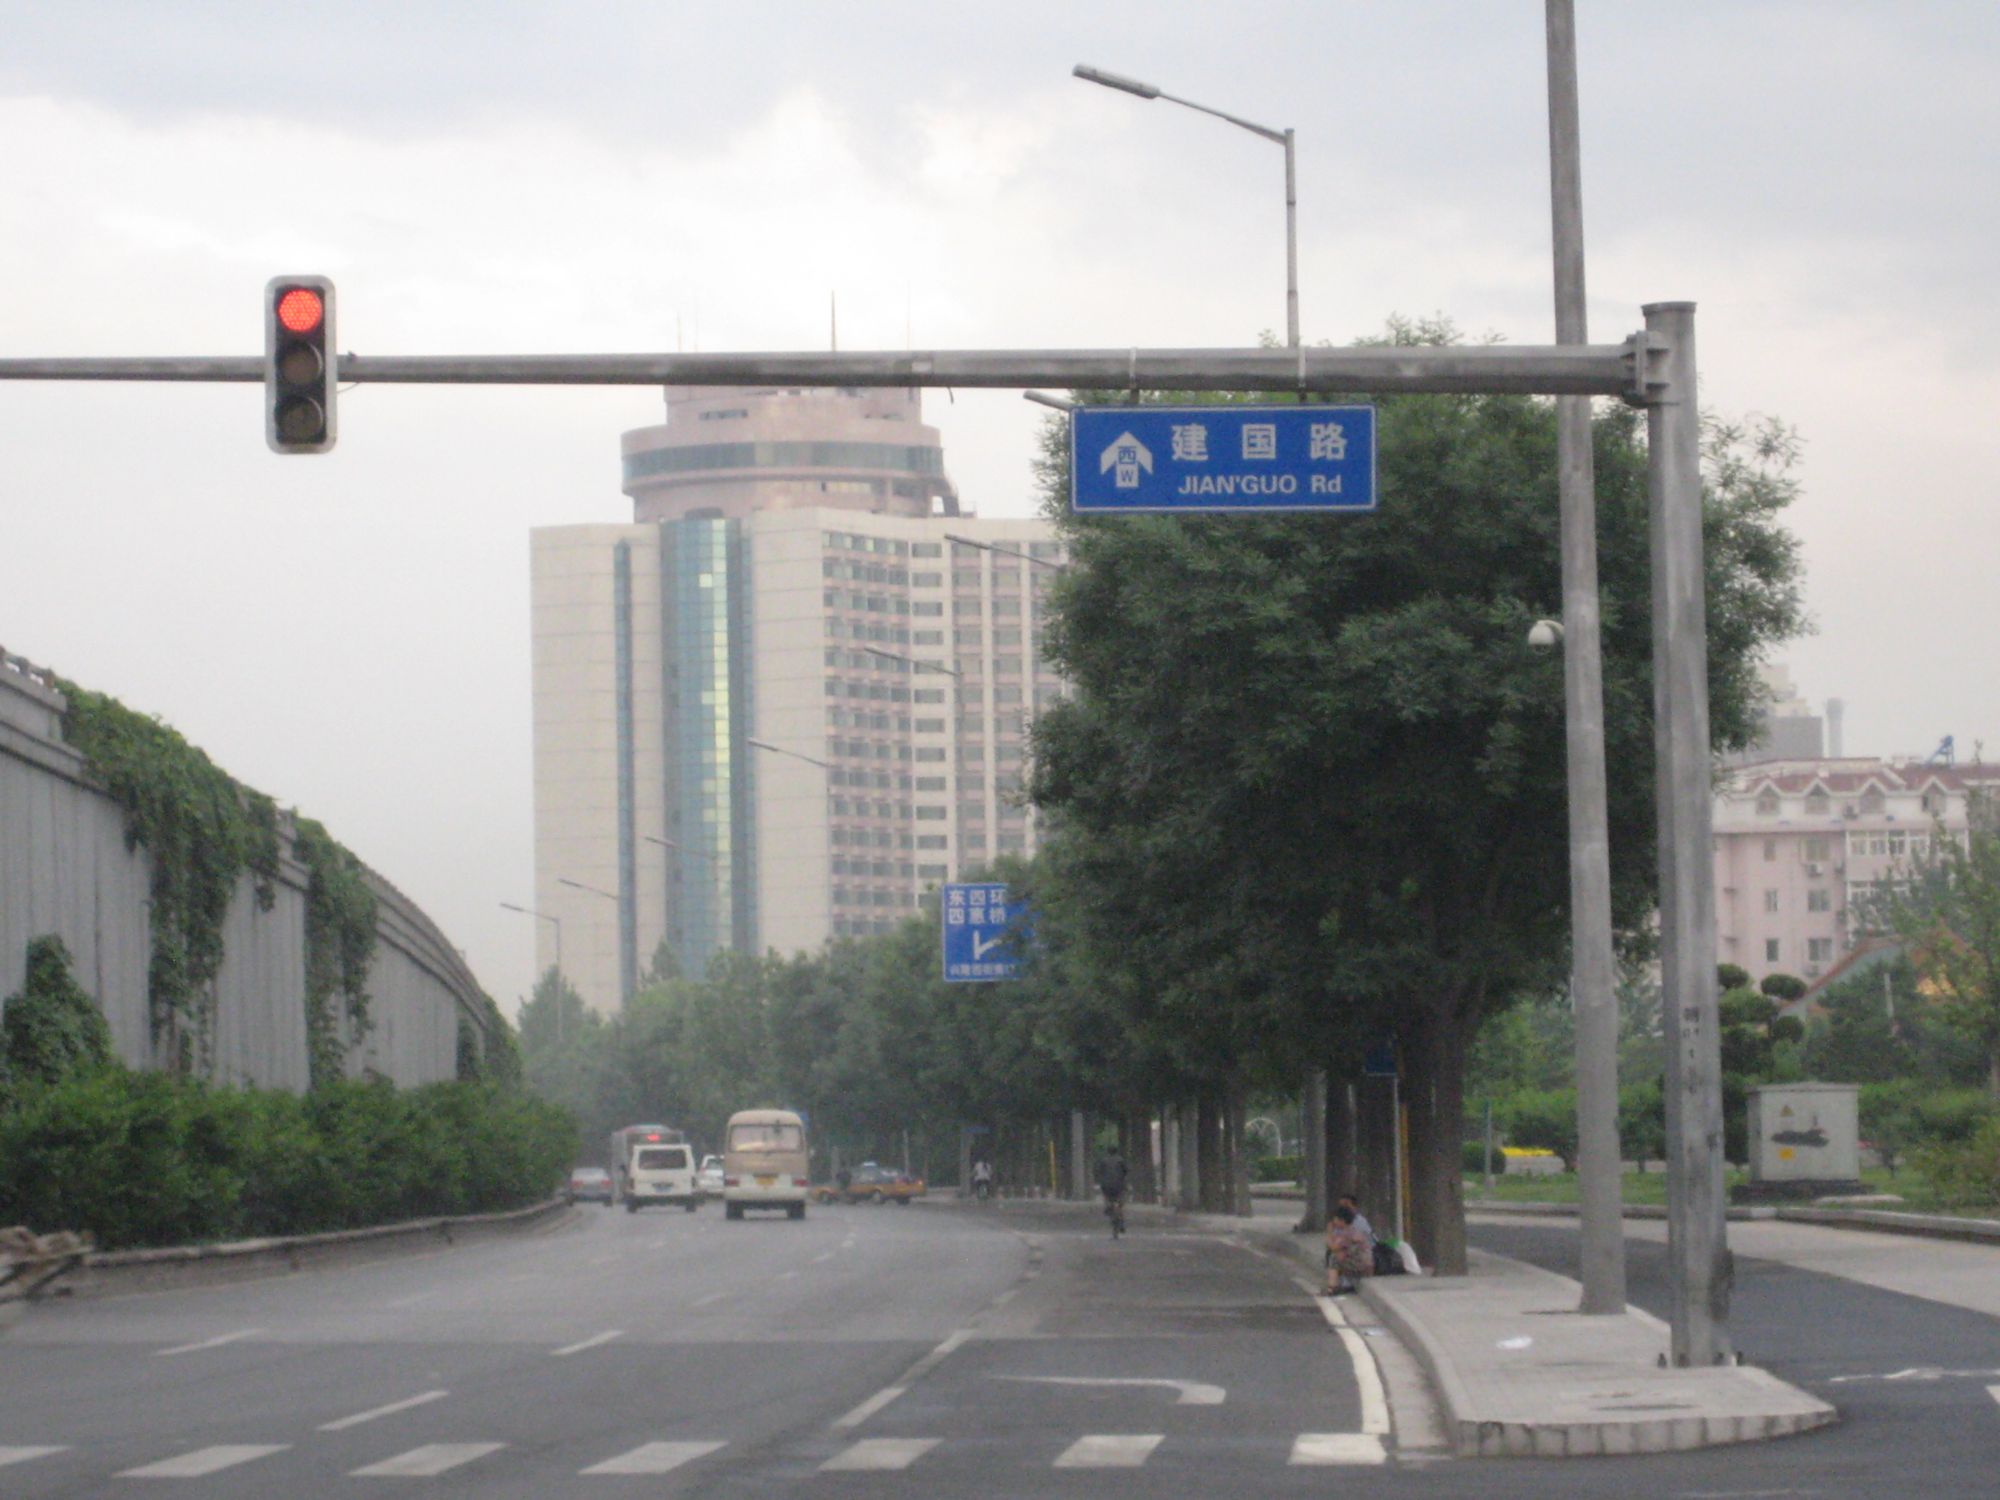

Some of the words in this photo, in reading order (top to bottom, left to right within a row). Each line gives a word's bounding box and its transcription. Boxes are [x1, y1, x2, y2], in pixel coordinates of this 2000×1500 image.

[1171, 423, 1347, 461] 建国路
[1117, 446, 1136, 464] 西
[1120, 469, 1134, 482] W
[1178, 474, 1298, 495] JIAN'GUO
[1311, 474, 1342, 494] Rd
